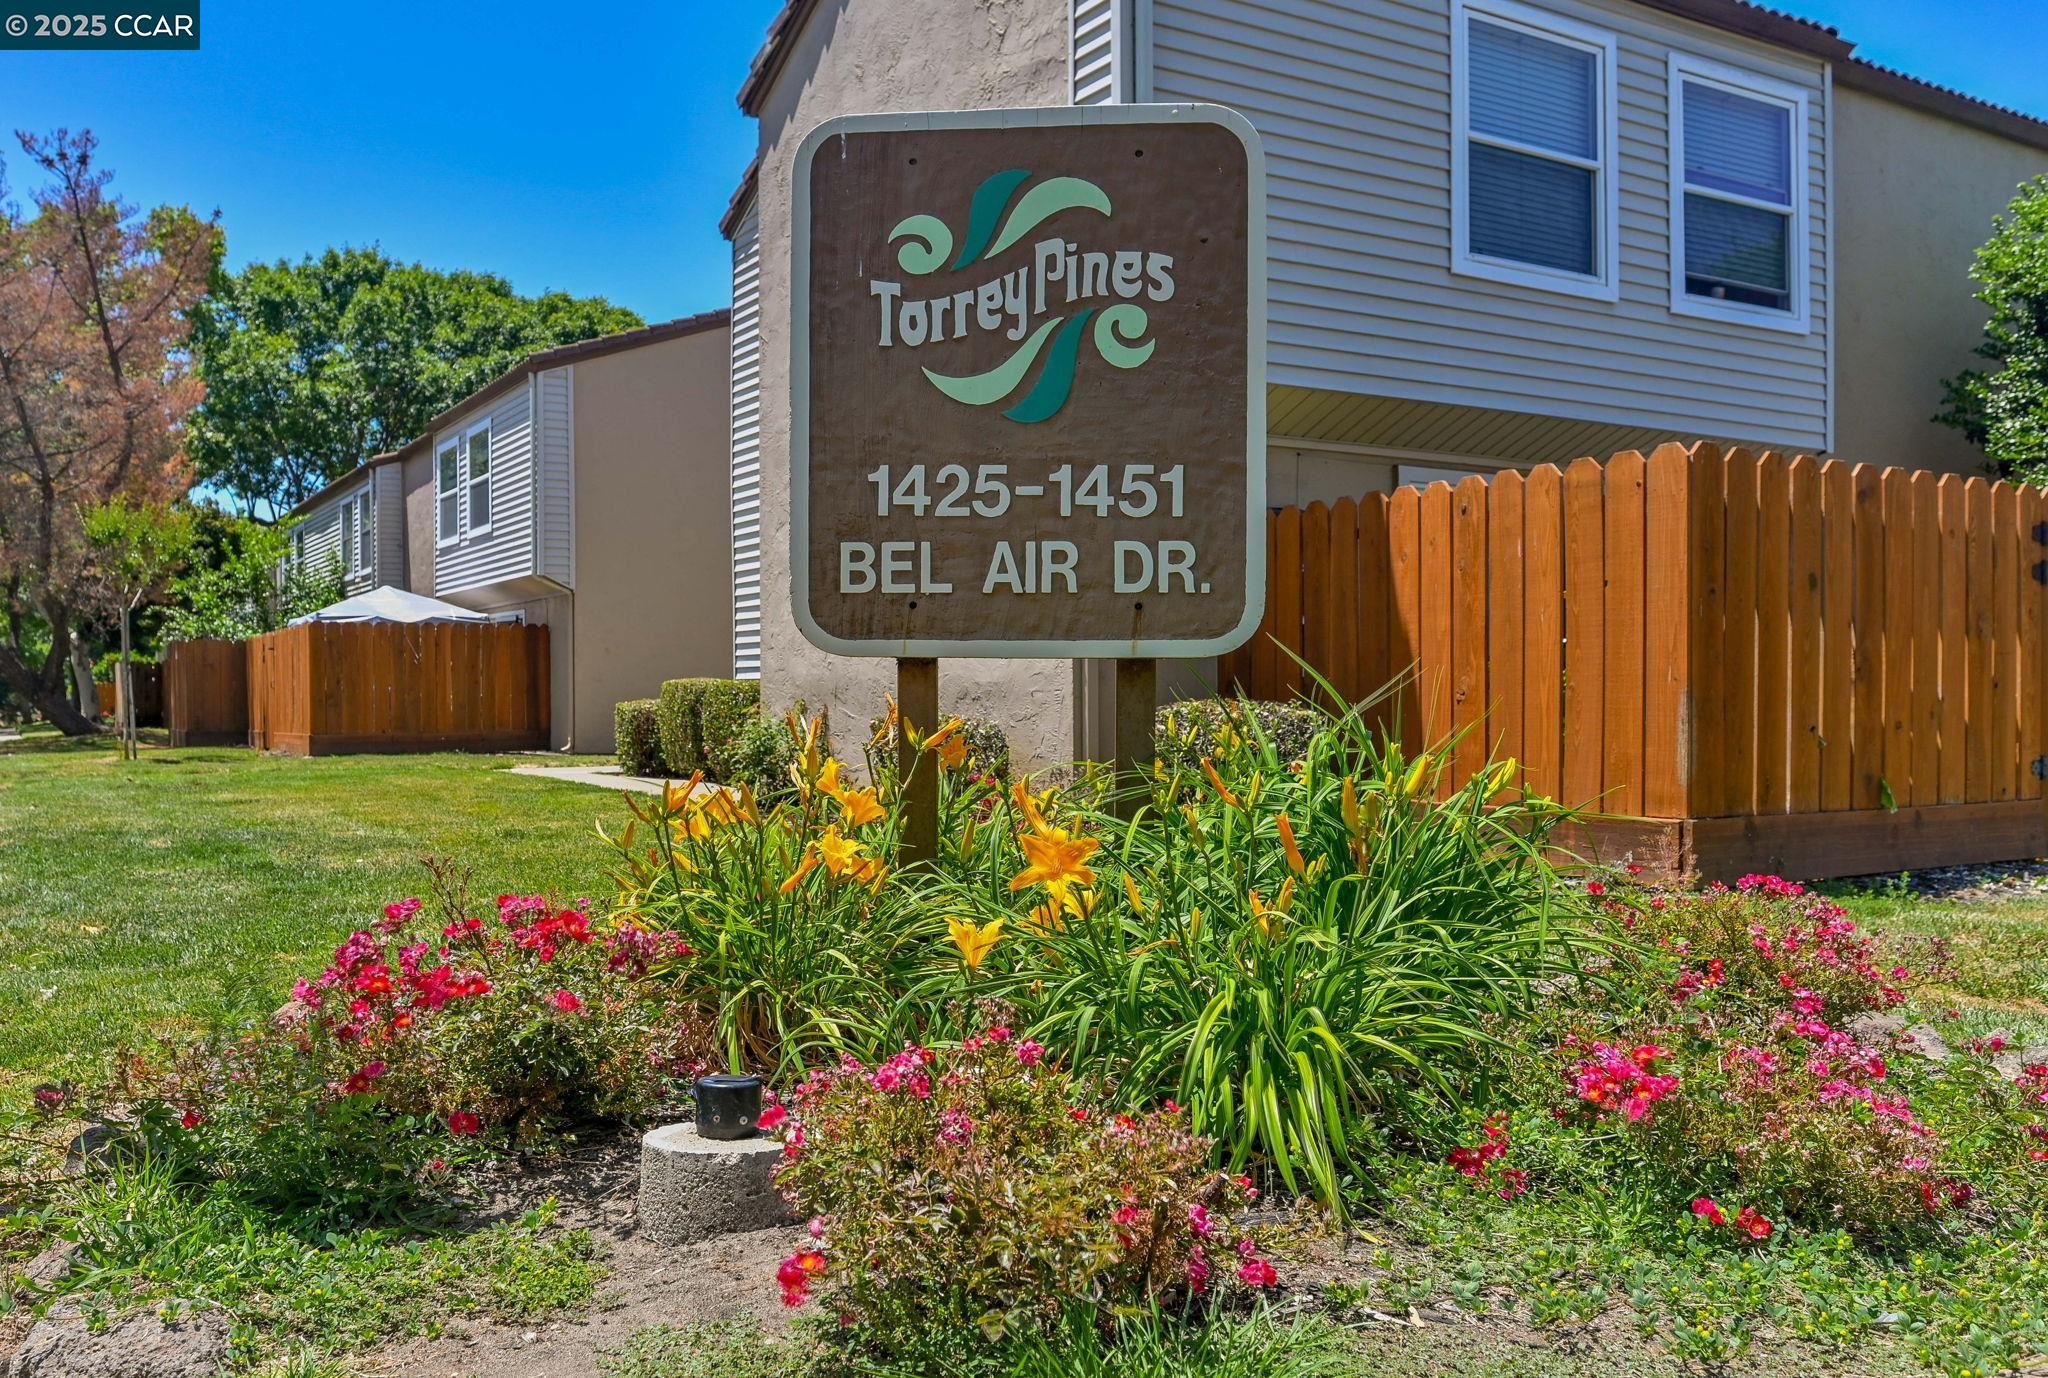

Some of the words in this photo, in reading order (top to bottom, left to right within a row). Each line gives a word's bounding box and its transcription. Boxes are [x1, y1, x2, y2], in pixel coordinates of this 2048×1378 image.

[870, 266, 1029, 347] Torrey
[1034, 237, 1176, 315] Pines
[867, 464, 1185, 518] 1425-1451
[840, 540, 953, 594] BEL
[982, 540, 1079, 594] AIR
[1114, 540, 1211, 594] DR.
